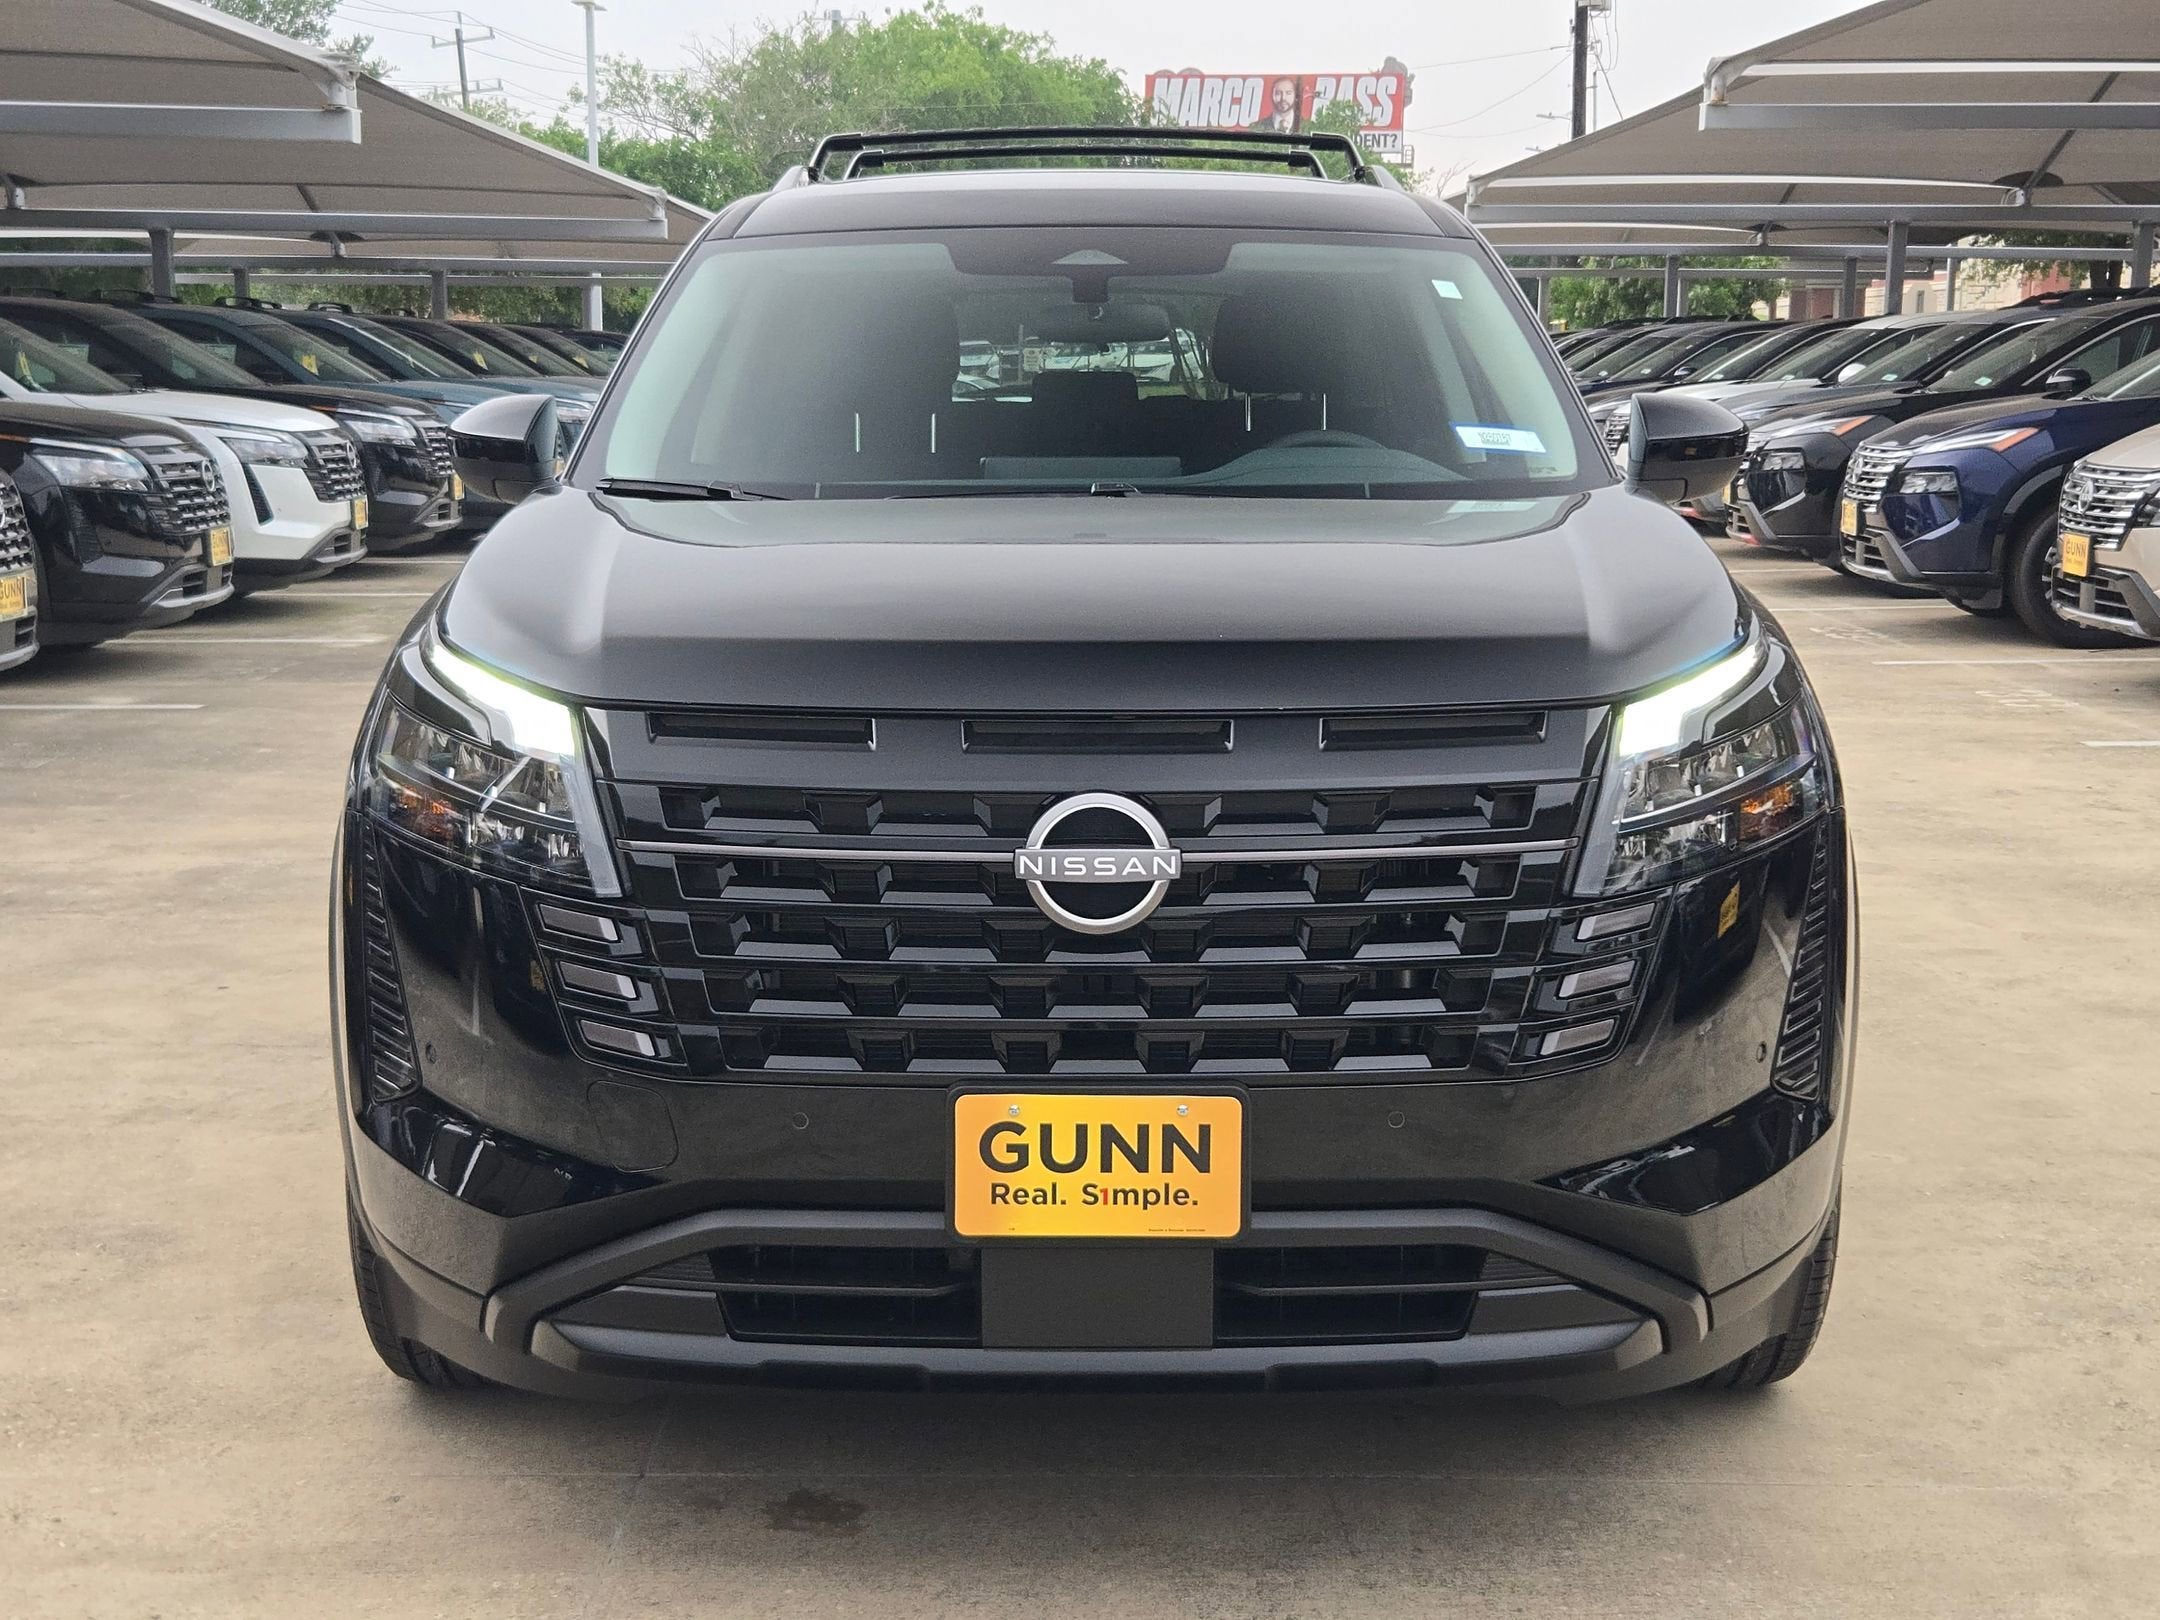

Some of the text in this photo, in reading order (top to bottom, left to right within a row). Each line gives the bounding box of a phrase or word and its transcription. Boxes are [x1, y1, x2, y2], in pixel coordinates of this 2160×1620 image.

[1154, 78, 1264, 127] MARCO
[1353, 133, 1398, 149] DENT?
[2065, 539, 2087, 558] GUNN
[1019, 855, 1176, 876] NISSAN
[978, 1120, 1212, 1174] GUNN
[990, 1182, 1199, 1210] Real. S1mple.
